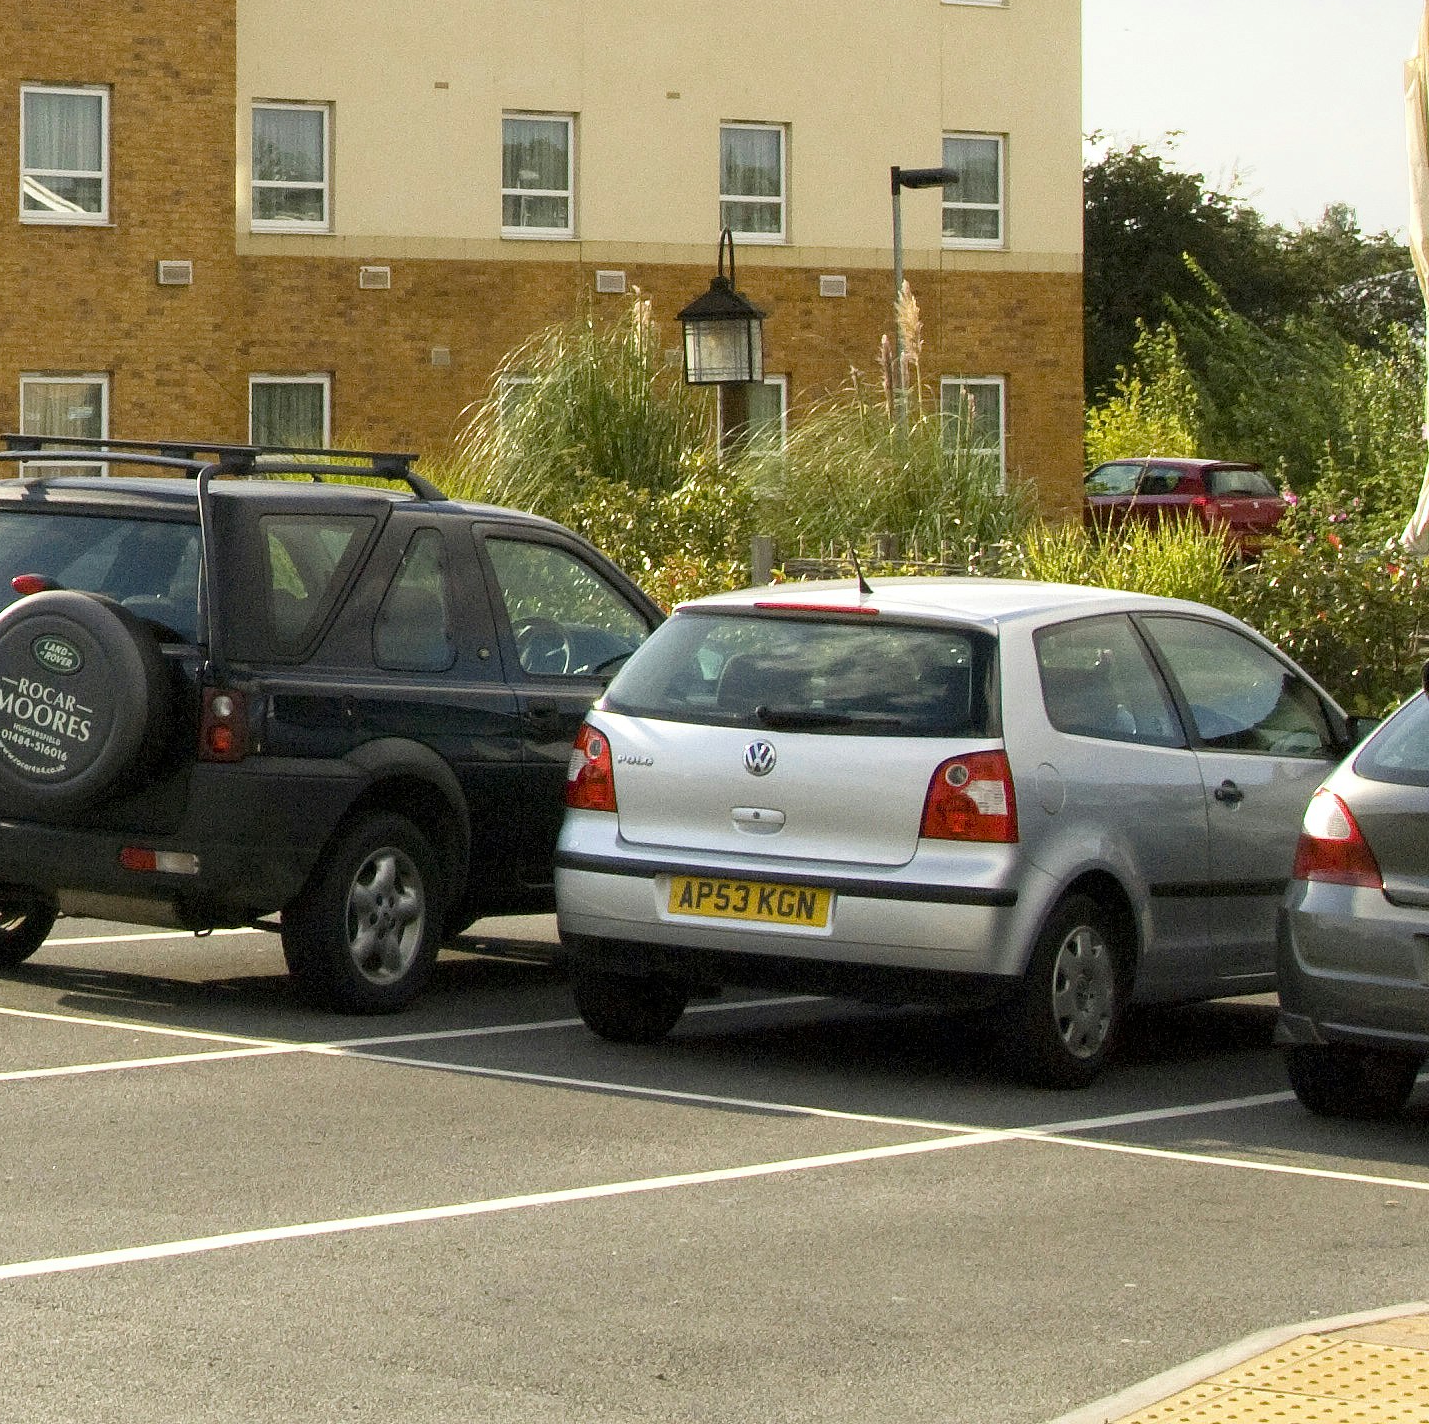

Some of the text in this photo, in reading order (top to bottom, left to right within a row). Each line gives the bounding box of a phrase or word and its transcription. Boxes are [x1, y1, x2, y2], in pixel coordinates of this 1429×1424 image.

[44, 641, 68, 656] LAND
[44, 651, 73, 668] ROVER
[18, 677, 76, 712] ROCAR
[1, 729, 68, 762] 01484-516016
[678, 880, 817, 920] AP53 KGN
